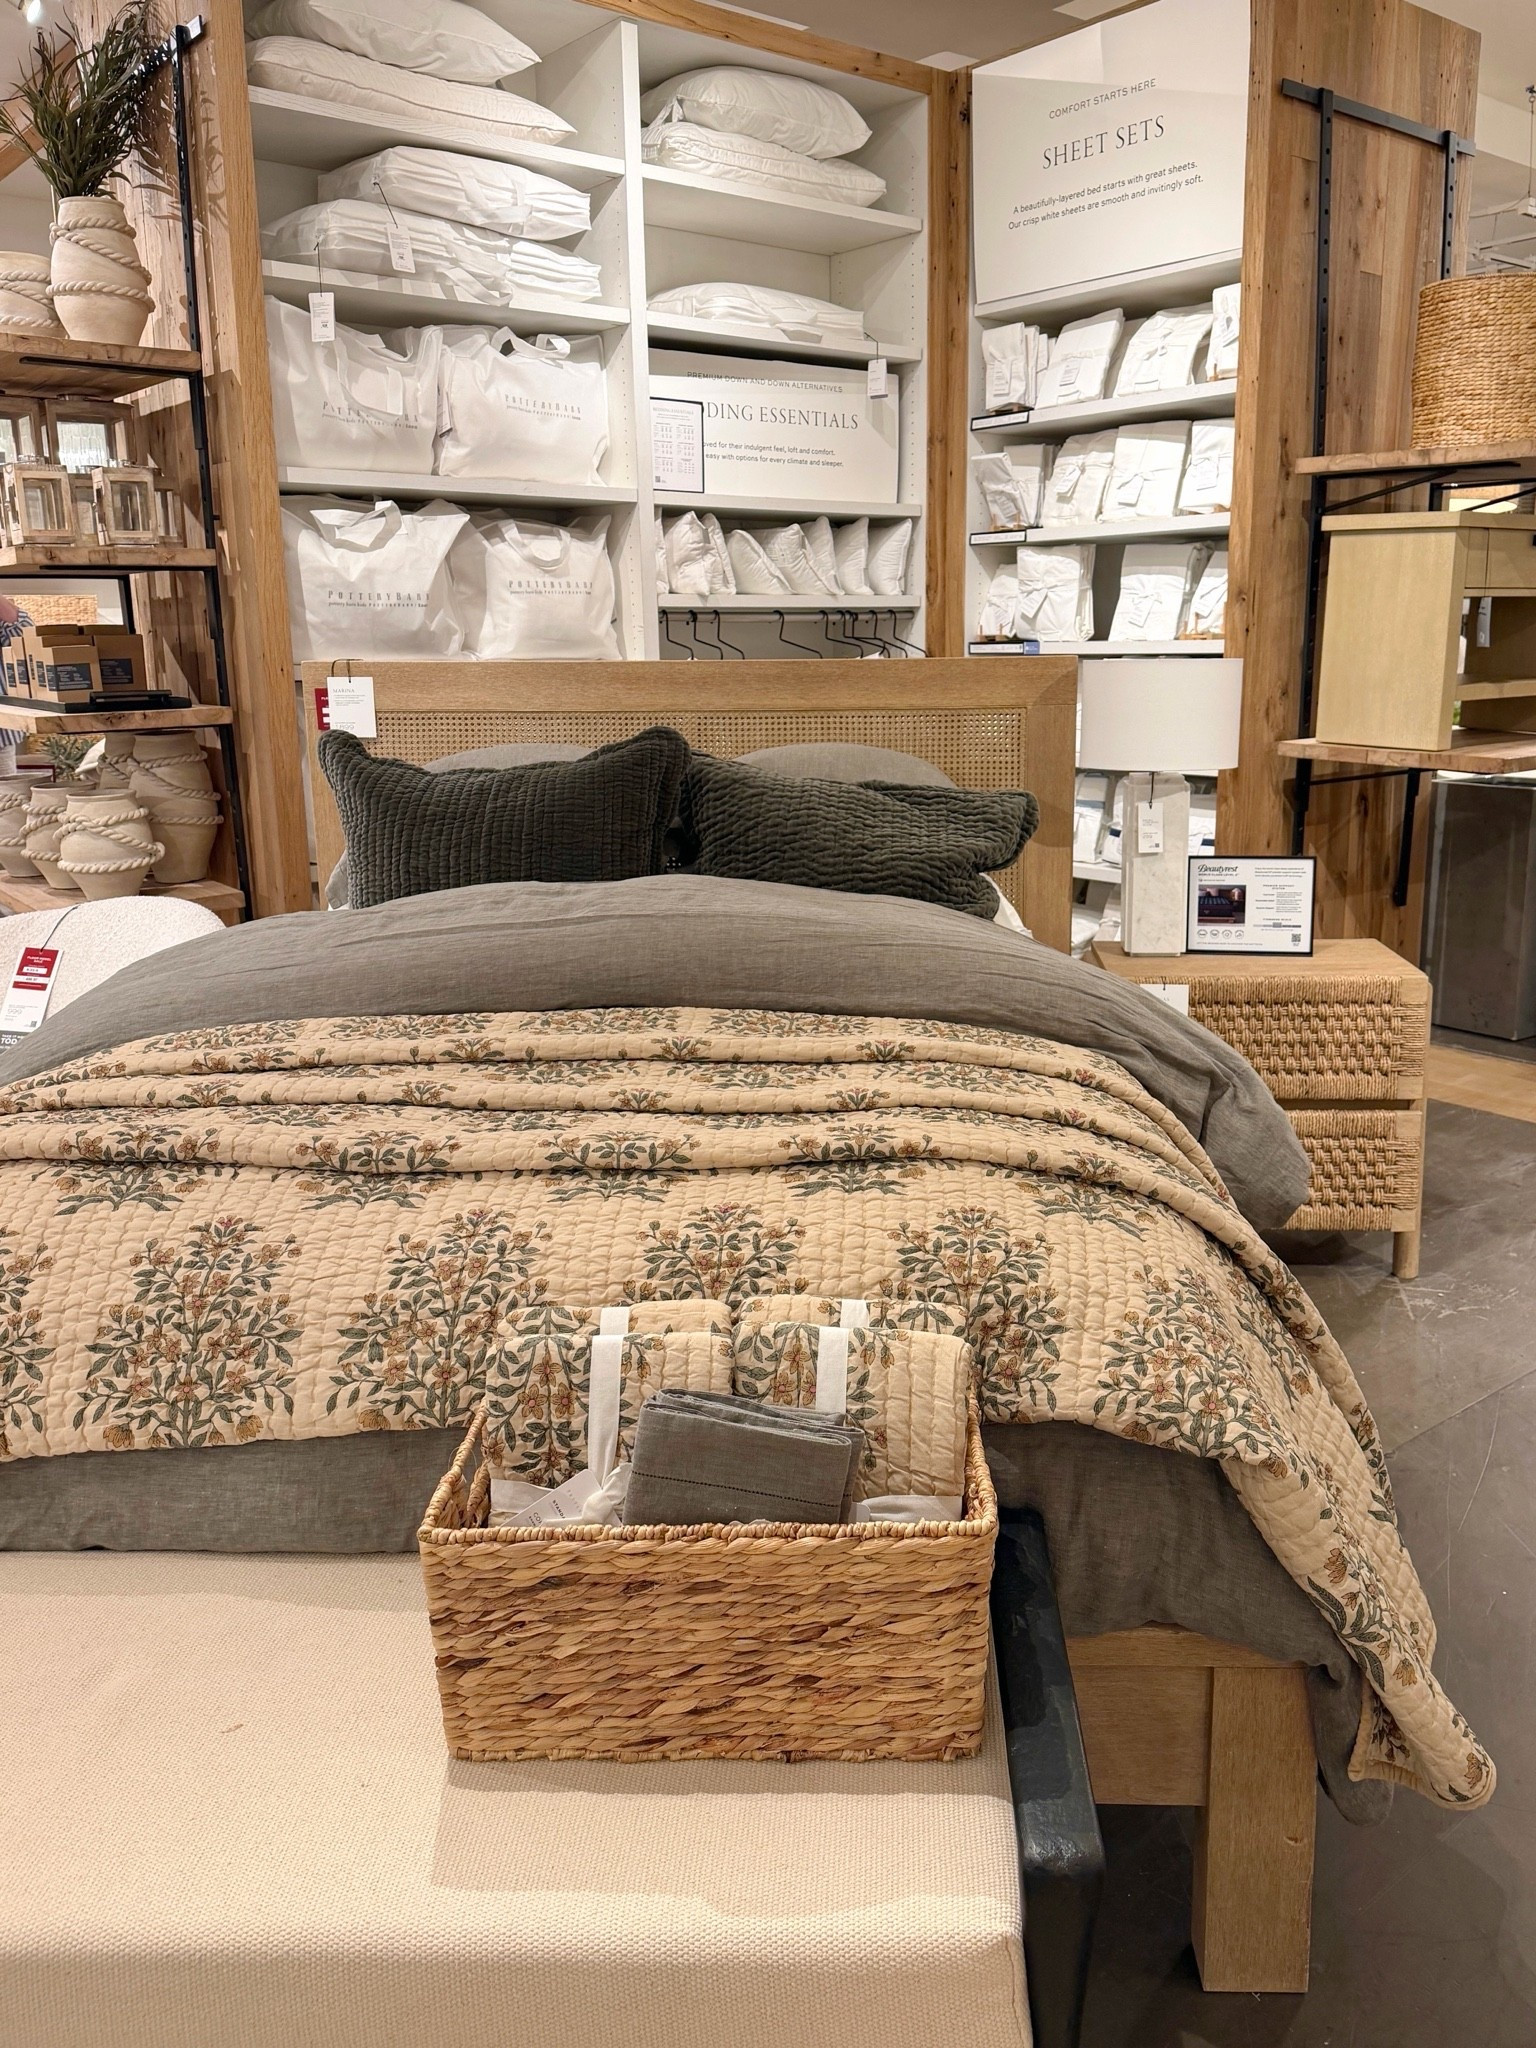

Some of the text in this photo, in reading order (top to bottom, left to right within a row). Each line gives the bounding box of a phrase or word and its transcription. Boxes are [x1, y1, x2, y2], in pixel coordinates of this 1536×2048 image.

[1049, 78, 1156, 119] COMFORT STARTS HERE
[1043, 114, 1164, 169] SHEET SETS
[1013, 206, 1019, 214] A
[1086, 184, 1101, 195] bed
[1103, 180, 1125, 191] starts
[1127, 174, 1143, 185] with
[1145, 168, 1166, 182] great
[1168, 161, 1197, 175] sheets.
[1008, 174, 1203, 230] Our crisp white sheets are smooth and invitingly soft.
[687, 371, 843, 393] PREMIUM DOWN AND DOWN ALTERNATIVES
[707, 402, 858, 430] DING ESSENTIALS
[744, 443, 772, 452] indulgent
[769, 457, 786, 465] every
[787, 457, 808, 465] climate
[1198, 864, 1239, 873] Beautyrest
